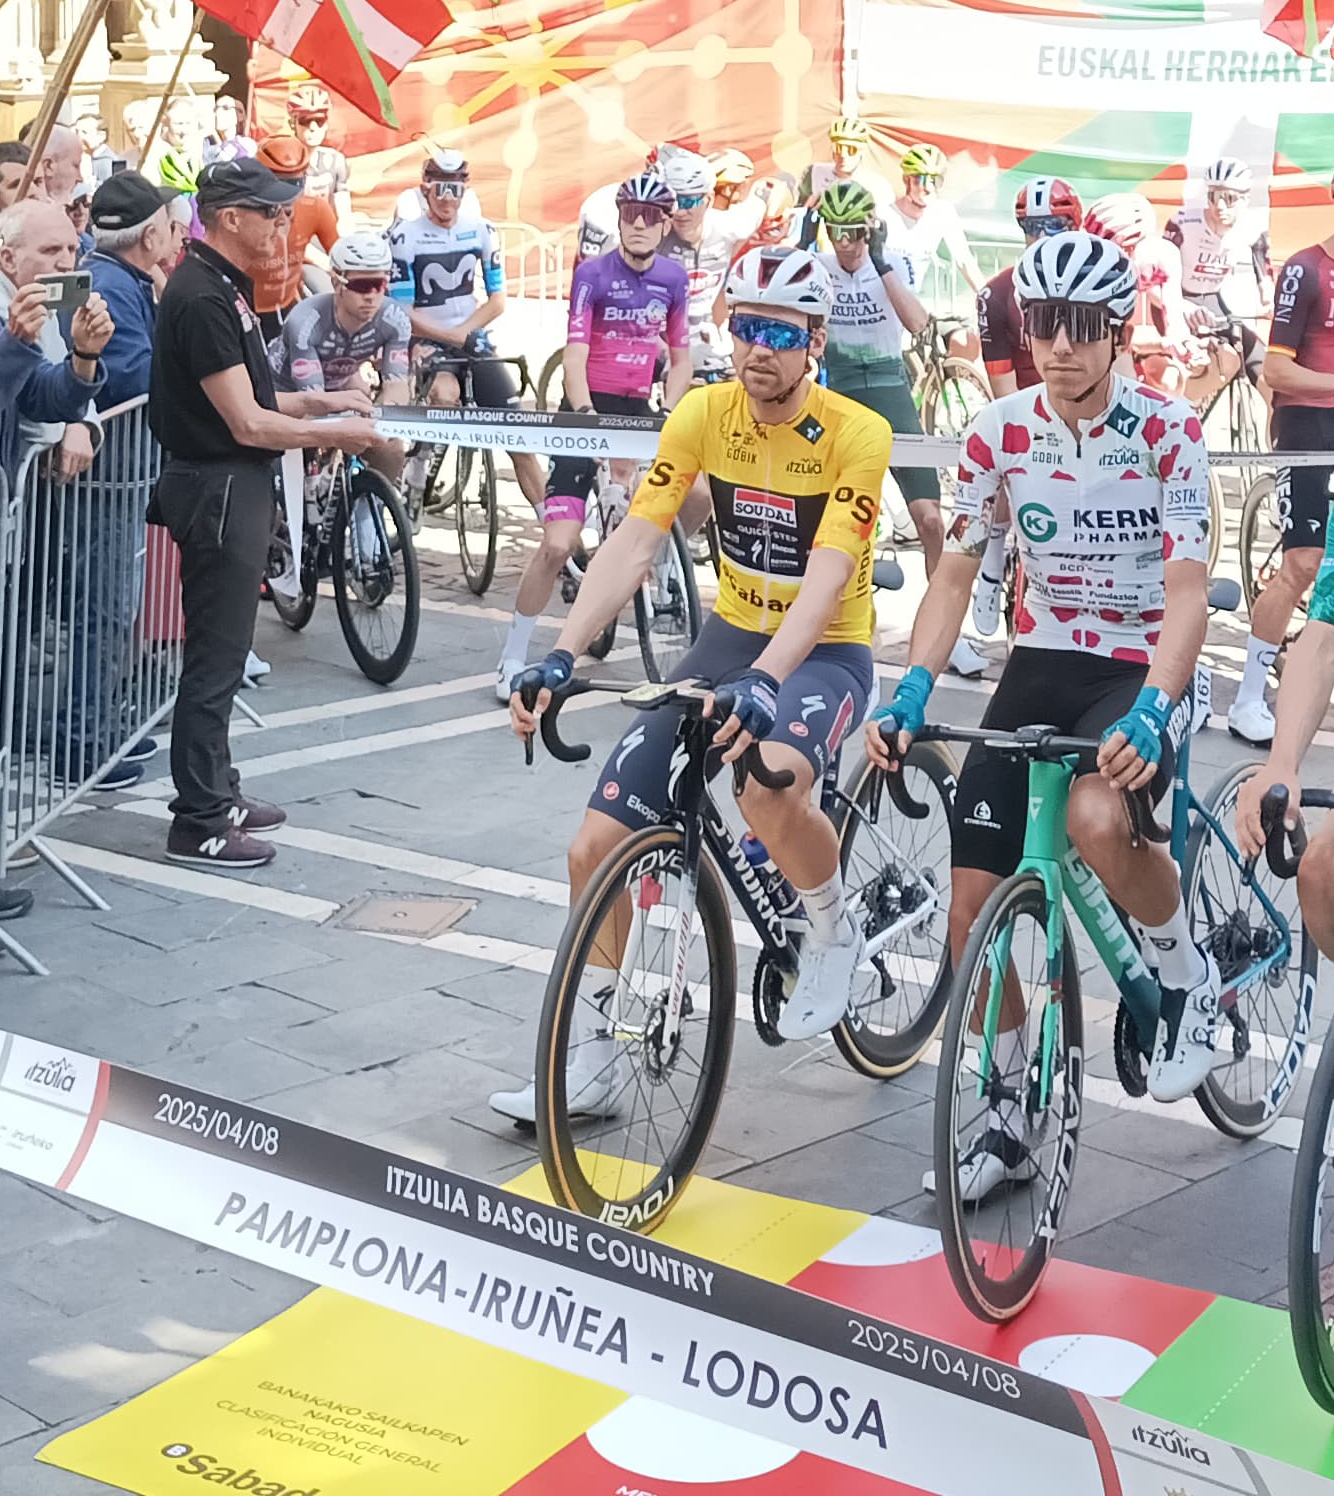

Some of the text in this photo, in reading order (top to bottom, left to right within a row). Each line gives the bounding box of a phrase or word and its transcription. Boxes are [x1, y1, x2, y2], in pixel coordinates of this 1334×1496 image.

[1038, 44, 1156, 83] EUSKAL
[1164, 47, 1305, 83] HERRIAK
[831, 304, 884, 317] RURAL
[1275, 264, 1304, 324] INEOS
[426, 409, 555, 424] ITZULIA BASQUE COUNTRY
[598, 416, 654, 428] 2025/04/08
[544, 435, 610, 451] LODOSA
[727, 446, 758, 465] GOBIK
[1032, 450, 1064, 465] GOBIK
[735, 503, 797, 527] SOUDAL
[1074, 507, 1160, 530] KERN
[1074, 531, 1162, 544] PHARMA
[1197, 670, 1211, 708] 167
[24, 1061, 77, 1093] itzulia
[154, 1092, 280, 1158] 2025/04/08
[598, 1175, 675, 1228] roval
[385, 1164, 716, 1300] ITZULIA BASQUE COUNTRY
[214, 1189, 630, 1367] PAMPLONA-IRUÑEA
[681, 1339, 889, 1451] LODOSA
[846, 1318, 1023, 1401] 2025/04/08
[256, 1378, 472, 1449] BANAKAKO SAILKAPEN
[302, 1407, 388, 1440] NAGUSIA
[215, 1398, 442, 1475] CLASIFICACIÓN GENERAL
[256, 1426, 364, 1467] INDIVIDUAL
[1131, 1424, 1212, 1468] itzulia
